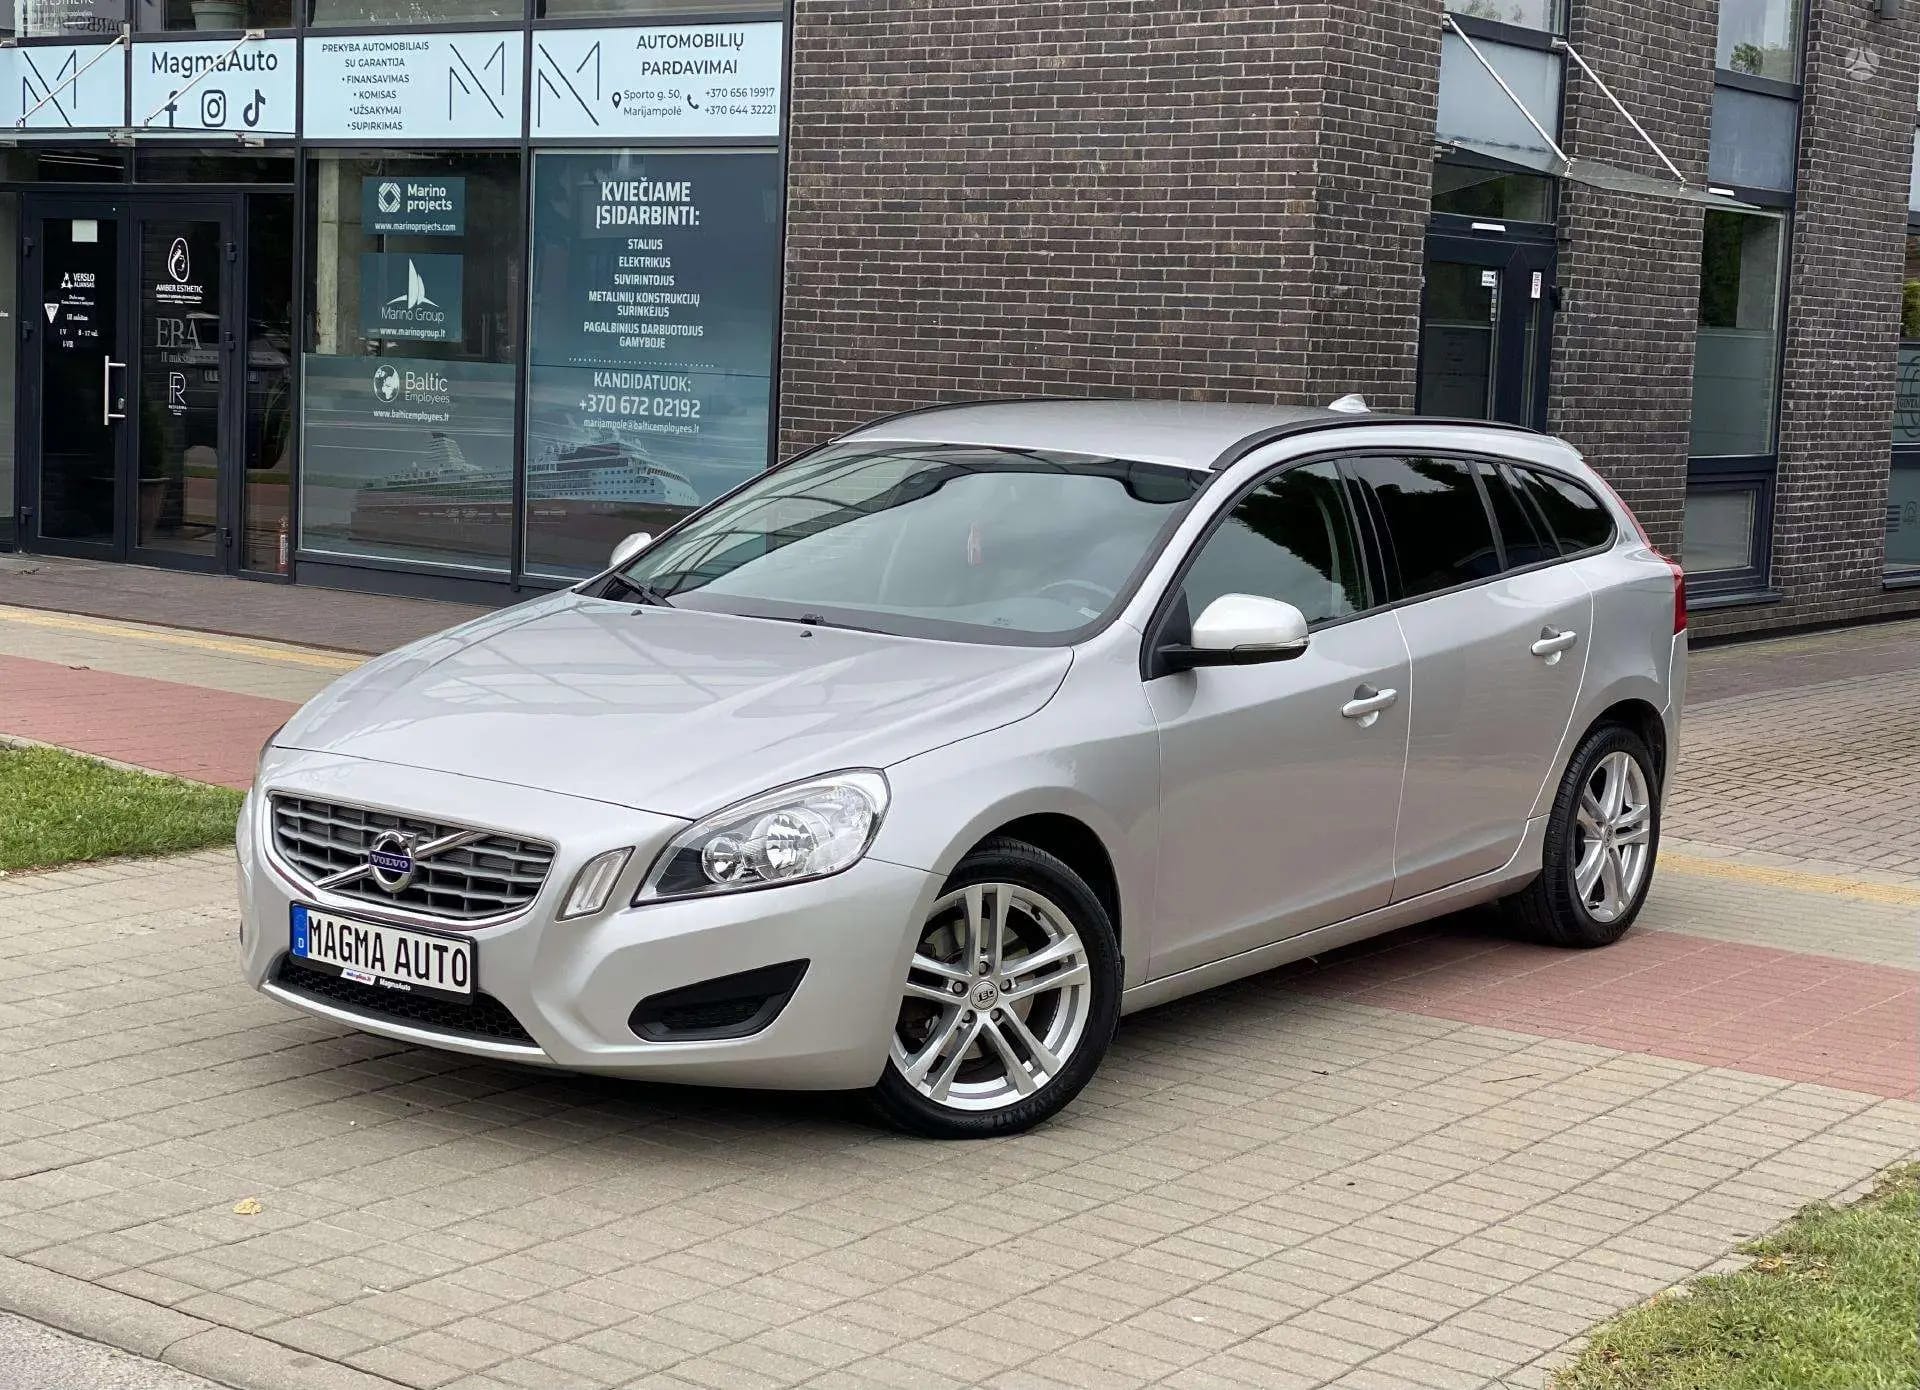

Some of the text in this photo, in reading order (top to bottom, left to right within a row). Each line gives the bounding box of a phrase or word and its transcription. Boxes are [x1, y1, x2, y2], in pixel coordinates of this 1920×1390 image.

[322, 41, 430, 52] PREKYBA AUTOMOBILIAIS
[636, 32, 745, 51] AUTOMOBILIŲ
[152, 49, 278, 78] MagmaAuto
[345, 57, 405, 67] SU GARANTIJA
[641, 60, 738, 76] PARDAVIMAI
[346, 74, 410, 84] FINANSAVIMAS
[359, 90, 397, 99] KOMISAS
[623, 89, 655, 102] Sporto
[657, 90, 666, 101] g.
[705, 87, 776, 98] +370 656 19917
[353, 104, 402, 115] UŽSAKYMAI
[623, 105, 682, 118] Marijampolė
[704, 104, 777, 115] +370 644 32221
[351, 121, 403, 131] SUPIRKIMAS
[407, 184, 446, 197] Marino
[602, 177, 691, 202] KVIEČIAME
[407, 197, 453, 213] projects
[596, 205, 700, 229] ĮSIDARBINTI:
[374, 221, 456, 233] www.marinoprojects.com
[628, 238, 663, 250] STALIUS
[618, 256, 671, 268] ELEKTRIKUS
[73, 273, 95, 282] VERSLO
[614, 273, 675, 286] SUVIRINTOJUS
[156, 284, 203, 294] AMBER ESTHETIC
[588, 290, 700, 308] METALINIŲ KONSTRUKCIJŲ
[381, 306, 445, 324] Marino Group
[380, 327, 446, 339] www.marinogroup.lt
[583, 321, 704, 336] PAGALBINIUS DARBUOTOJUS
[619, 336, 666, 348] GAMYBOJE
[405, 371, 448, 392] Baltic
[594, 371, 692, 393] KANDIDATUOK:
[405, 391, 450, 404] Employees
[579, 393, 701, 418] +370 672 02192
[373, 409, 449, 422] www.balticemployees.lt
[371, 854, 409, 869] VOLVO
[298, 937, 304, 948] D
[308, 915, 468, 987] MAGMA AUTO
[380, 977, 411, 991] MagmaAuto
